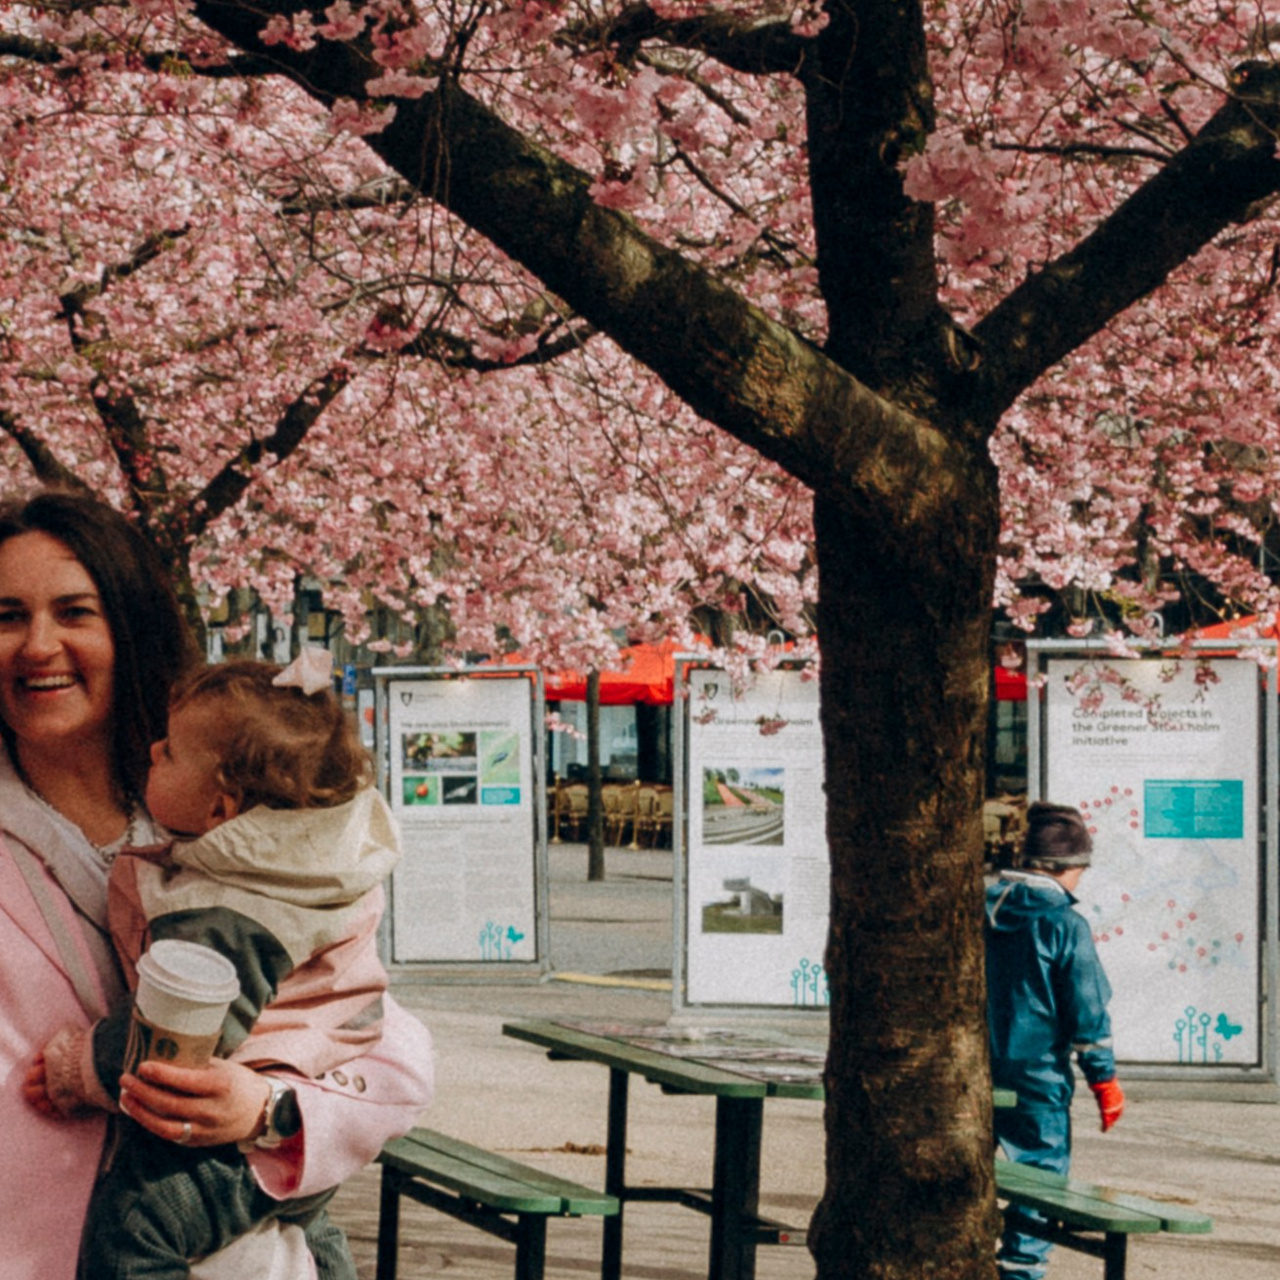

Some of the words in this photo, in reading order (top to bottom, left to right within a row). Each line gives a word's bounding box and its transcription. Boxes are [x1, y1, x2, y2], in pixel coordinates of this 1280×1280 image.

[1149, 708, 1197, 721] rojects
[1201, 707, 1213, 719] in
[1072, 722, 1093, 732] the
[1097, 721, 1149, 732] Greener
[1151, 721, 1220, 732] Stoholm
[1072, 736, 1128, 746] initiative
